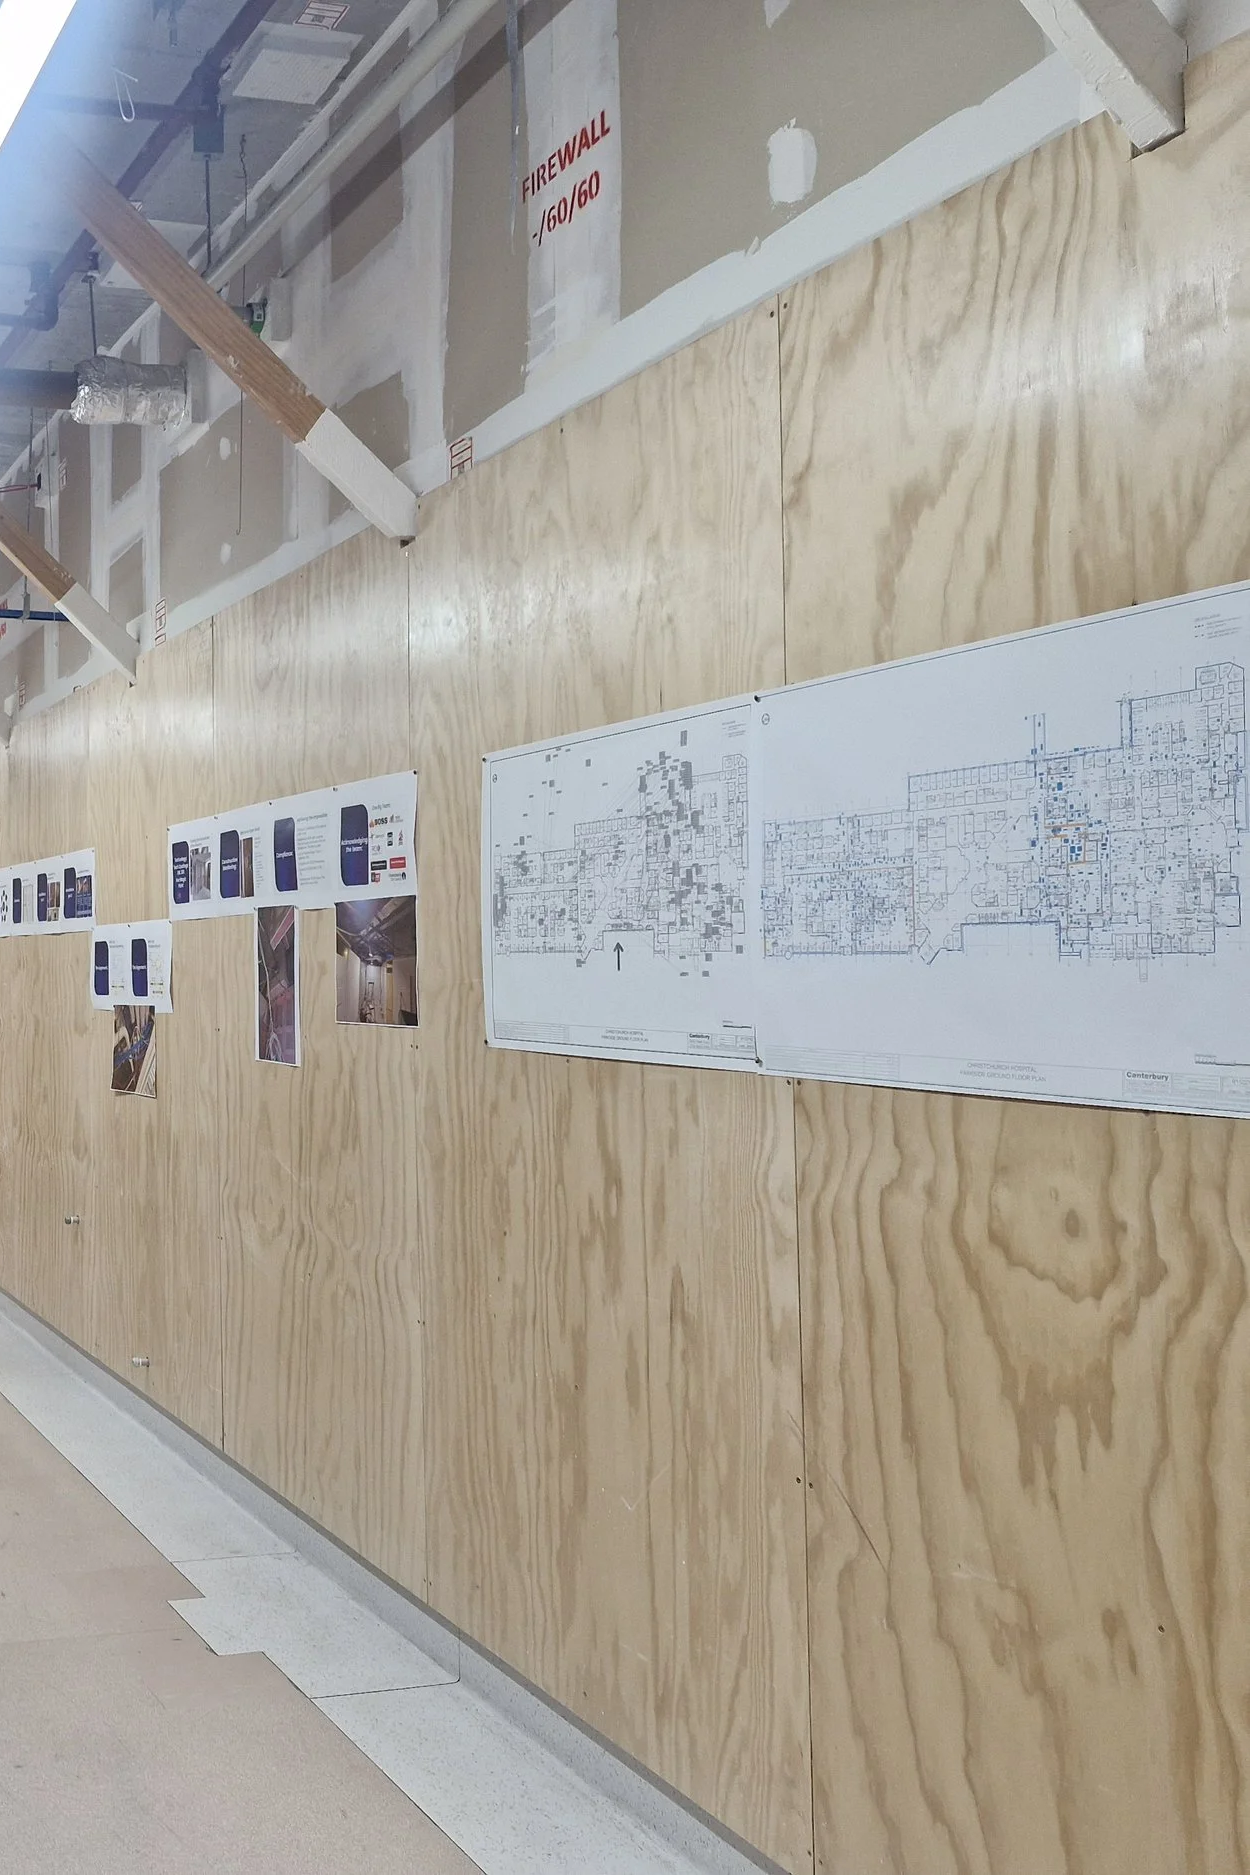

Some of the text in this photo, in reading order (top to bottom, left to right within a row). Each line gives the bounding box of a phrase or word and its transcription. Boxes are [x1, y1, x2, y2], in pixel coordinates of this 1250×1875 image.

[522, 109, 611, 204] FIREWALL
[532, 170, 600, 247] -/60/60
[967, 1062, 1009, 1070] CHRISTCHURCH
[1126, 1071, 1169, 1082] Canterbury
